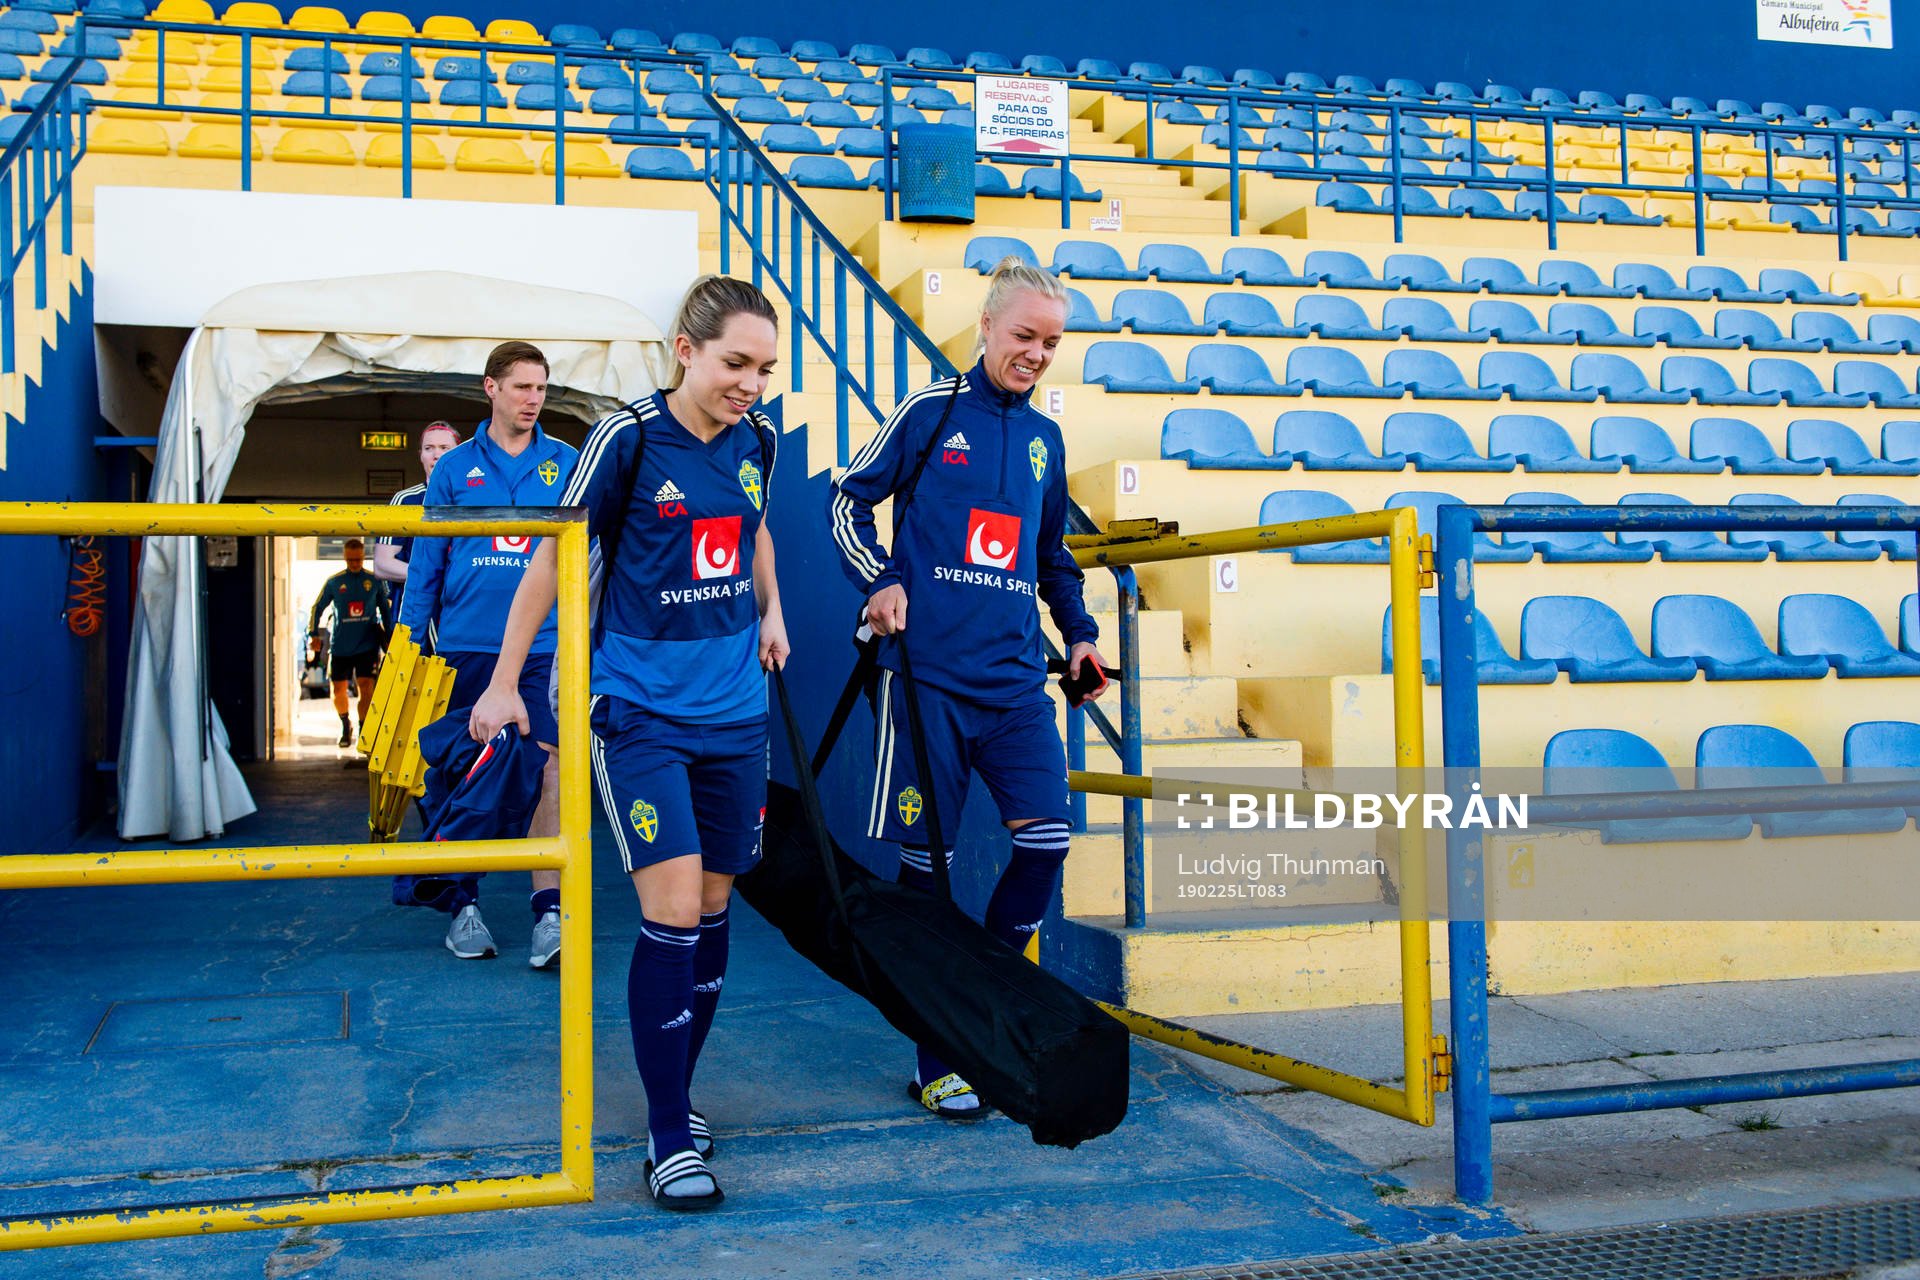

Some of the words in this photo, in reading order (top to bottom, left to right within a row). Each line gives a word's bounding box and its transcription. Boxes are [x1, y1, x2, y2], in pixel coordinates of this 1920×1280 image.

[1779, 12, 1840, 33] Albufeira
[996, 79, 1050, 92] LUGARES
[998, 103, 1029, 114] PARA
[1031, 105, 1048, 115] OS
[991, 113, 1034, 126] SÓCIOS
[1036, 117, 1053, 127] DO
[980, 126, 1000, 136] F.C.
[1002, 127, 1065, 140] FERREIRAS
[1110, 200, 1120, 217] H
[928, 273, 940, 293] G
[1050, 390, 1061, 414] E
[943, 442, 971, 451] adidas
[942, 450, 969, 466] ICA
[466, 477, 486, 488] ICA
[1123, 467, 1136, 492] D
[654, 492, 685, 503] adidas
[657, 501, 688, 518] ICA
[472, 556, 520, 568] SVENSKA
[933, 566, 1003, 589] SVENSKA
[1006, 578, 1034, 596] SPEL
[1220, 561, 1234, 589] C
[660, 584, 732, 605] SVENSKA
